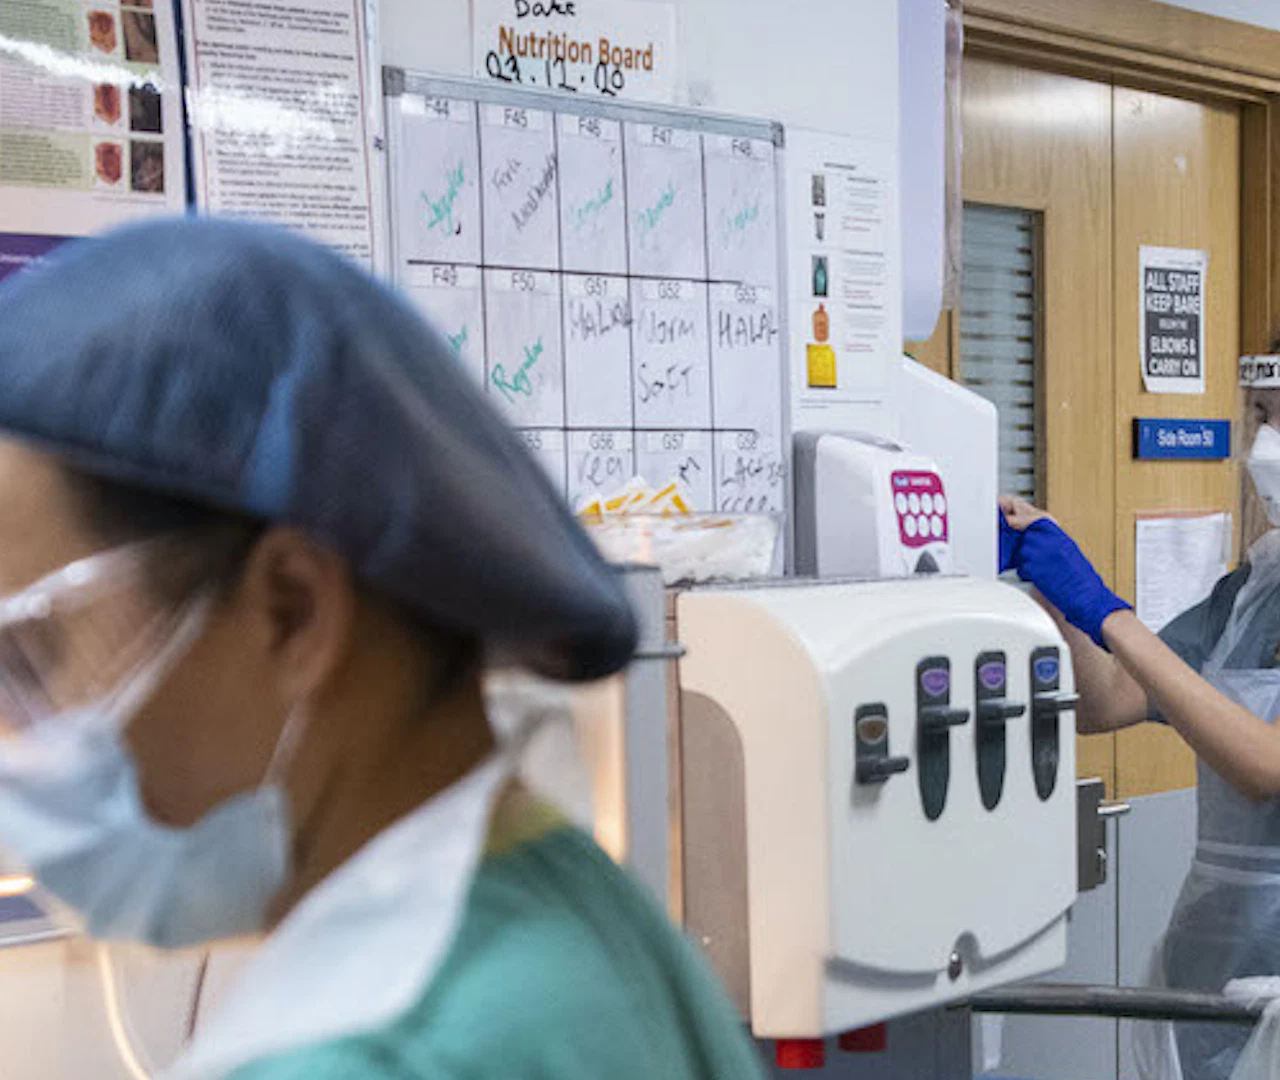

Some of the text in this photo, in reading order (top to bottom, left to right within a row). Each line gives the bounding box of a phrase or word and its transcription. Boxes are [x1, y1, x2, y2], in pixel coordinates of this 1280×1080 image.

[498, 25, 654, 72] Nutrition Board
[424, 98, 450, 118] F44
[503, 108, 529, 129] F45
[578, 117, 602, 138] F46
[652, 127, 673, 145] F47
[431, 266, 459, 287] F49
[511, 271, 536, 292] F50
[1146, 271, 1200, 293] ALL STAFF
[657, 281, 682, 300] G52
[1146, 294, 1200, 315] KEEP BARE
[1150, 336, 1188, 354] ELBOWS
[1148, 357, 1197, 376] CARRY ON
[662, 432, 685, 450] G57
[1157, 429, 1177, 448] Side
[1178, 430, 1201, 447] Room
